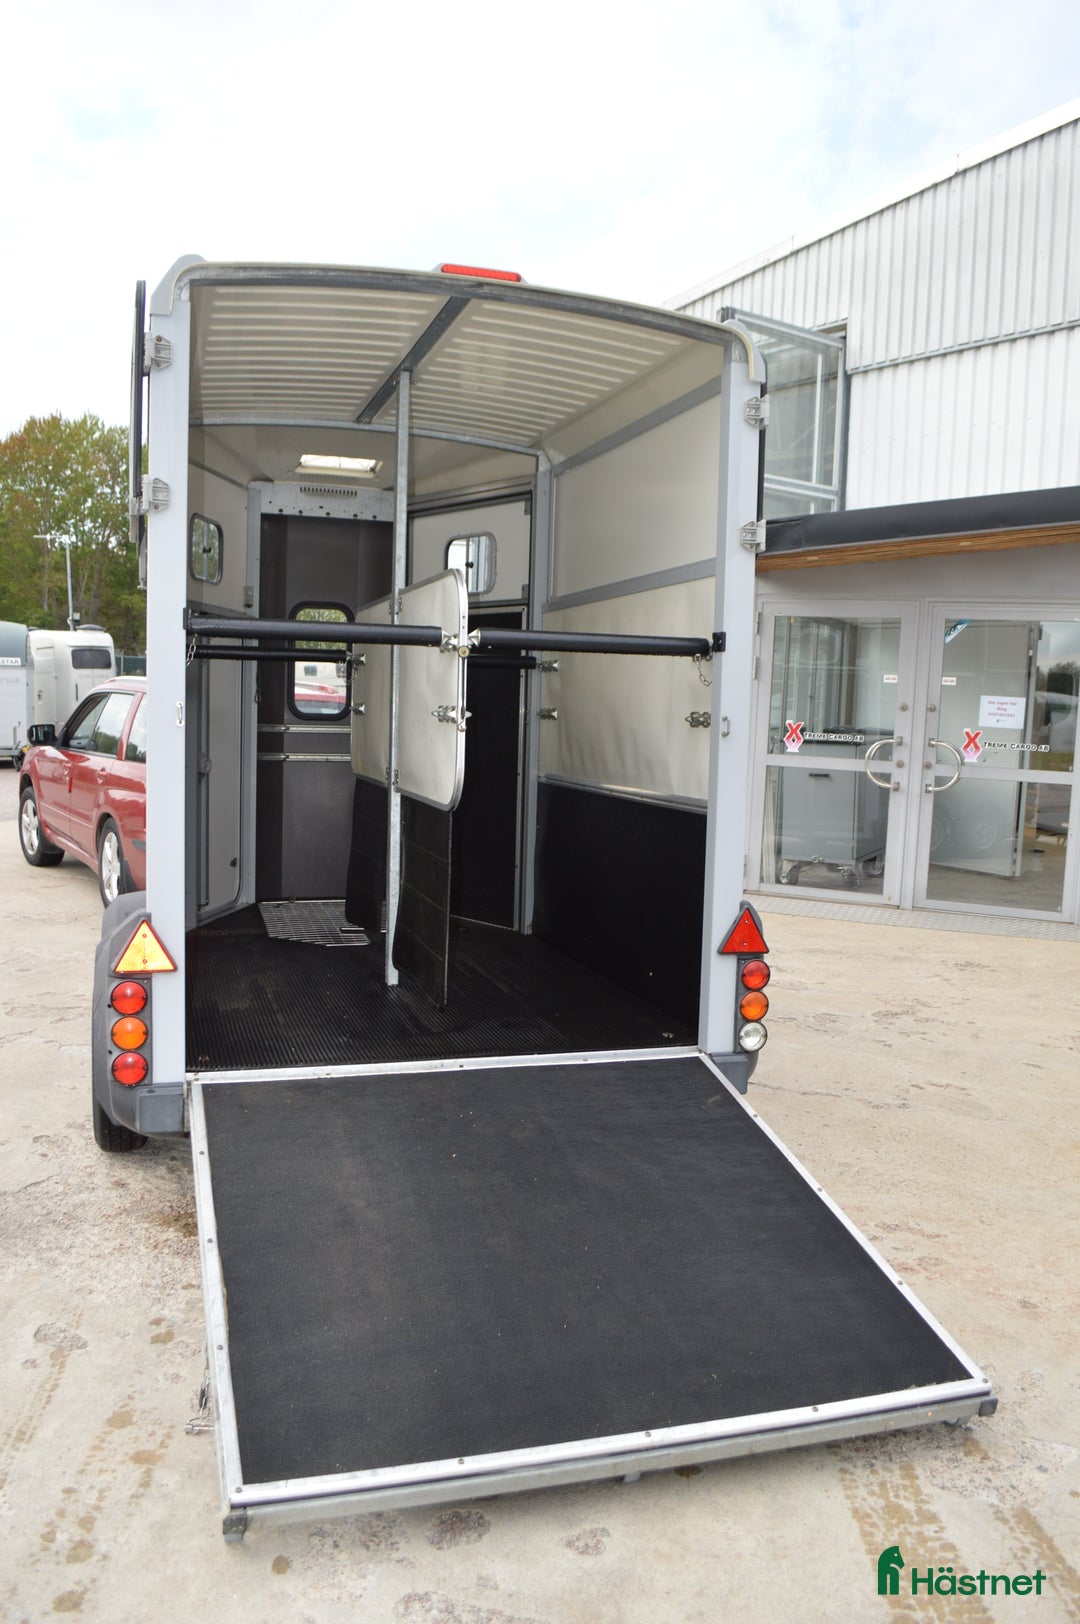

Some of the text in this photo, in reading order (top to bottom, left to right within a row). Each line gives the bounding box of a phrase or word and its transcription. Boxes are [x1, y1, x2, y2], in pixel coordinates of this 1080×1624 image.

[827, 732, 854, 741] CARGO
[853, 734, 865, 743] AB
[1010, 742, 1037, 752] CARGO
[1038, 744, 1050, 752] AB
